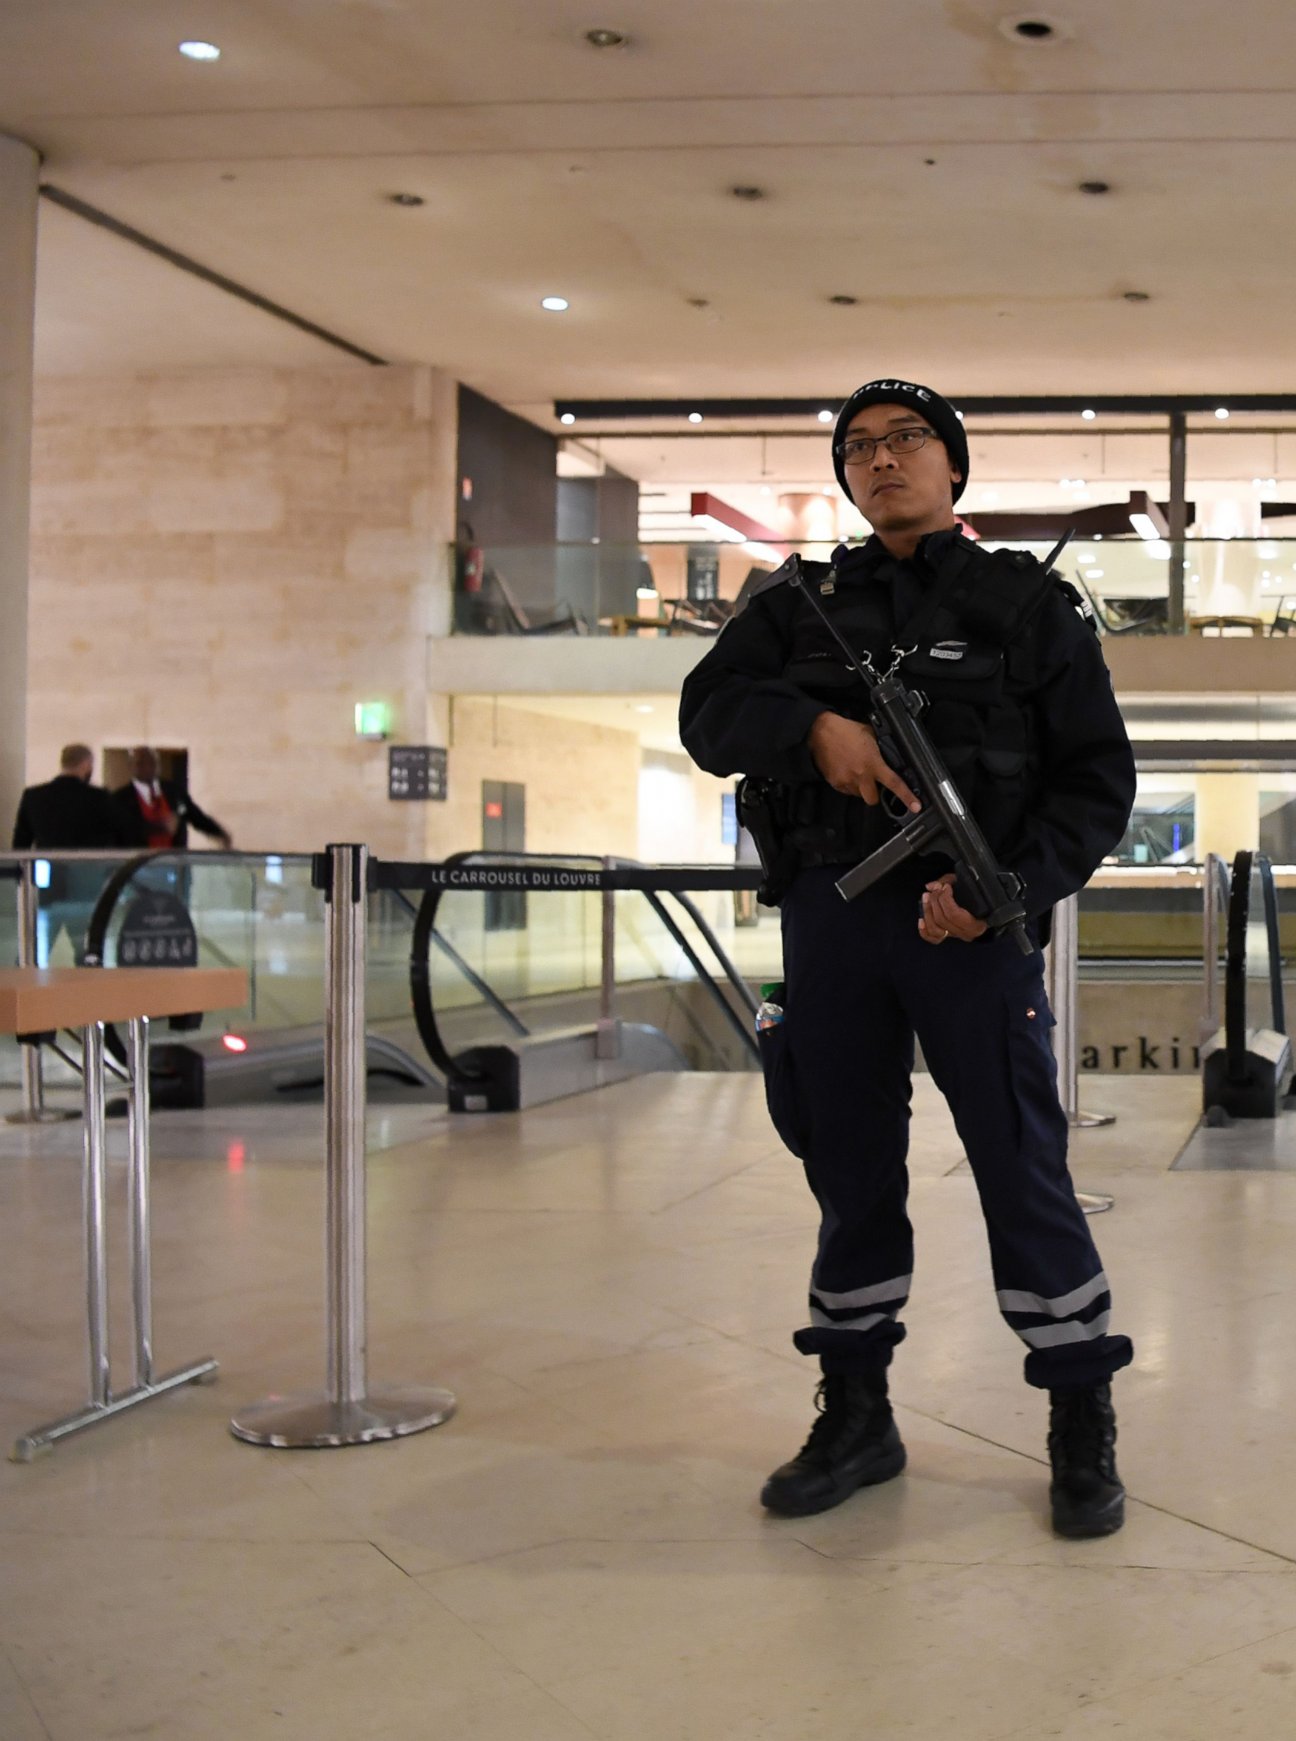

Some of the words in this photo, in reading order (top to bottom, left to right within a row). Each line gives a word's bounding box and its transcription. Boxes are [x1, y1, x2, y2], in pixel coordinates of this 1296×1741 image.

[431, 868, 446, 884] LE
[449, 868, 529, 886] CARROUSEL
[532, 870, 551, 886] DU
[553, 871, 601, 887] LOUVRE
